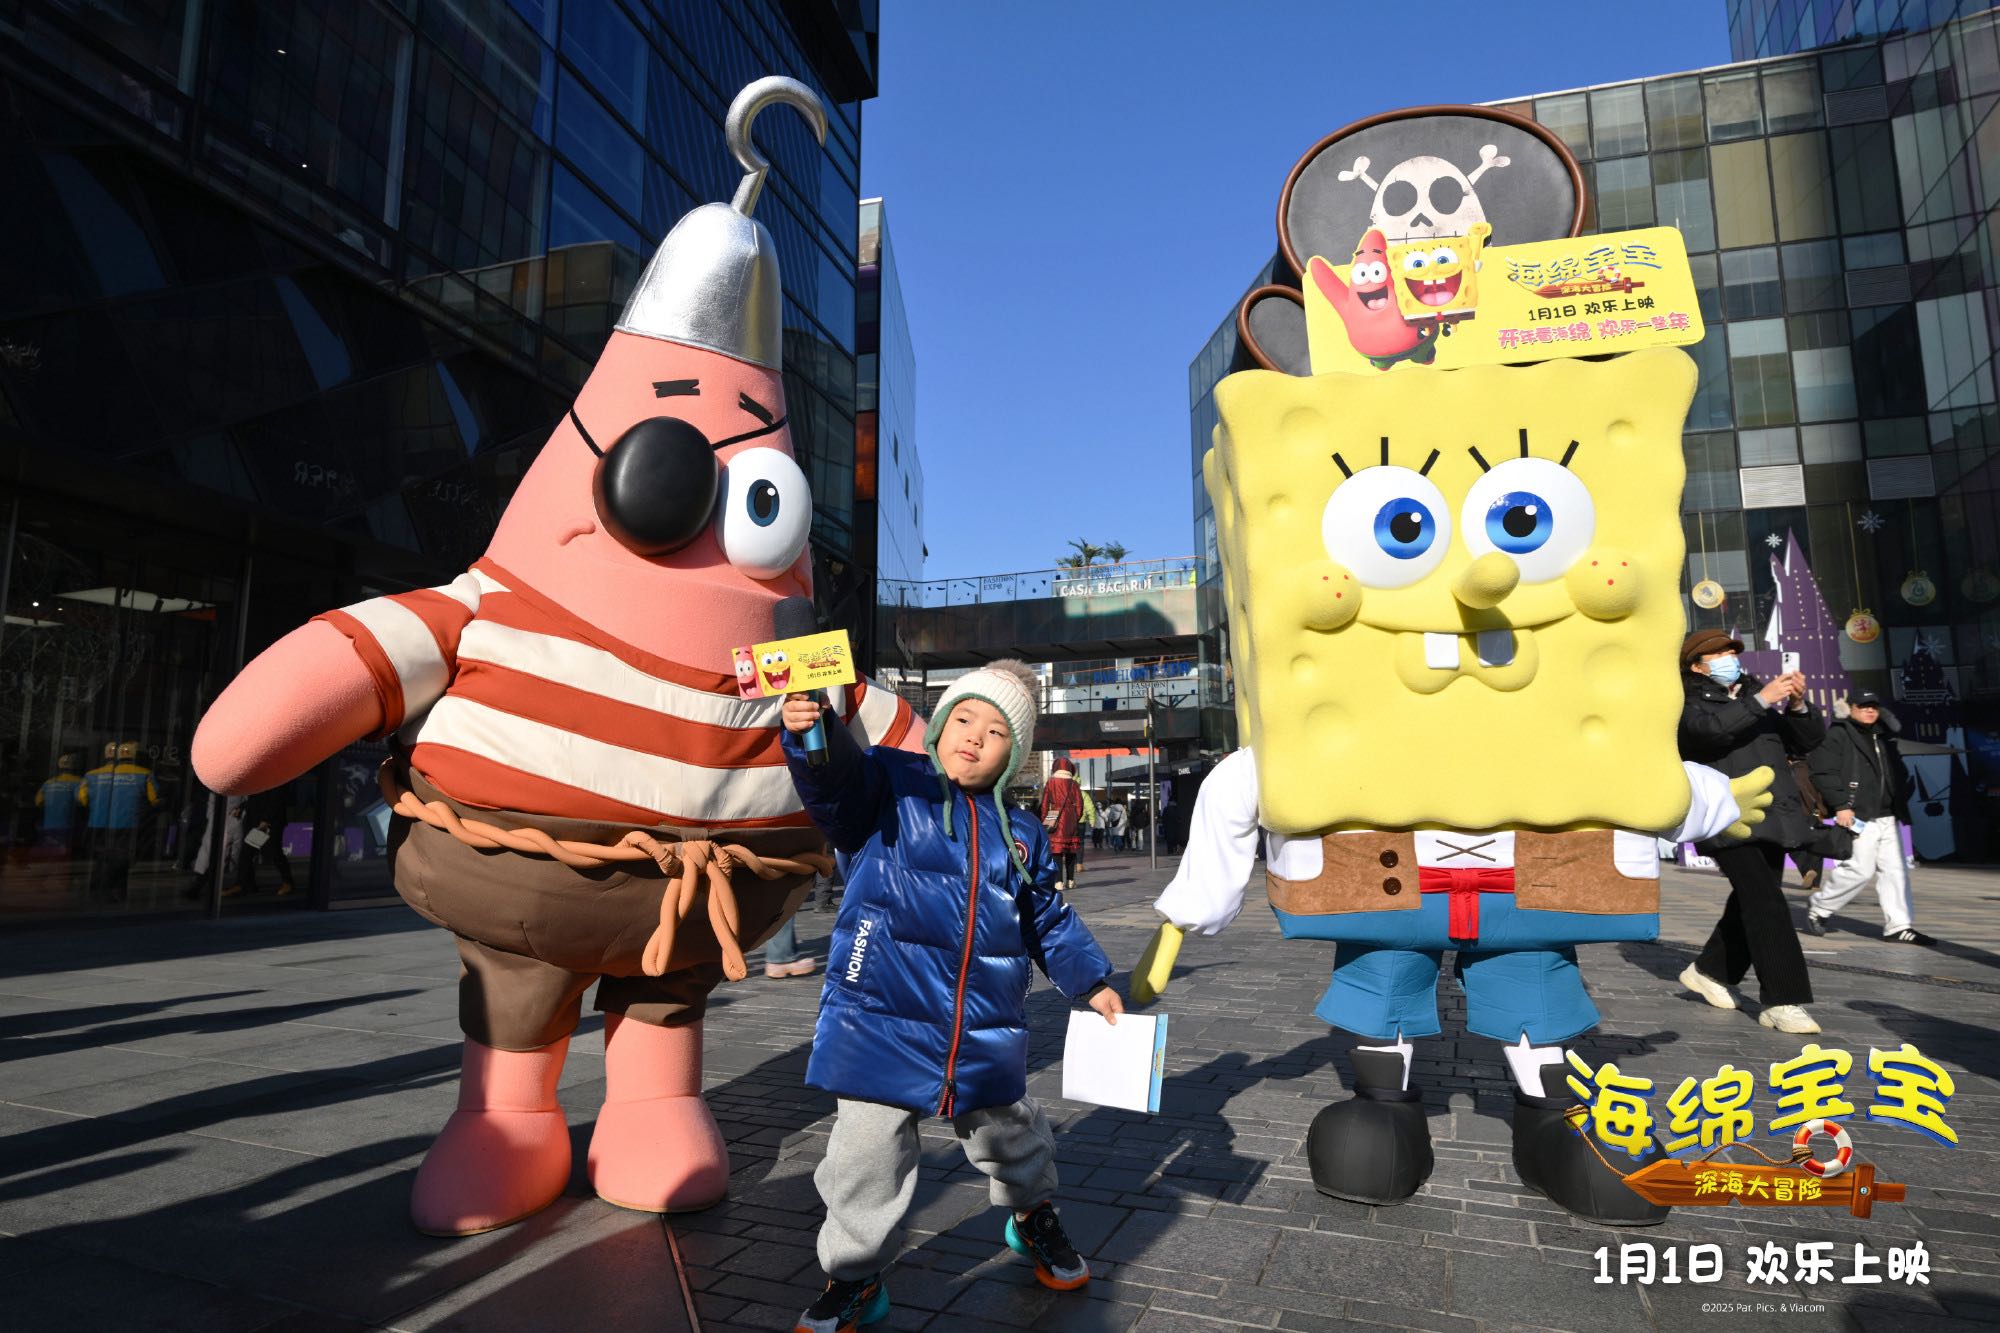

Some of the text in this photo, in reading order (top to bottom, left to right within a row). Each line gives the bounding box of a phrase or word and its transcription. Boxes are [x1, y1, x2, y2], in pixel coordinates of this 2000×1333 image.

[1505, 241, 1662, 287] 海绵宝宝
[1528, 295, 1655, 321] 1月1日 欢乐上映
[1060, 583, 1092, 597] CASA
[845, 919, 872, 983] FASHION
